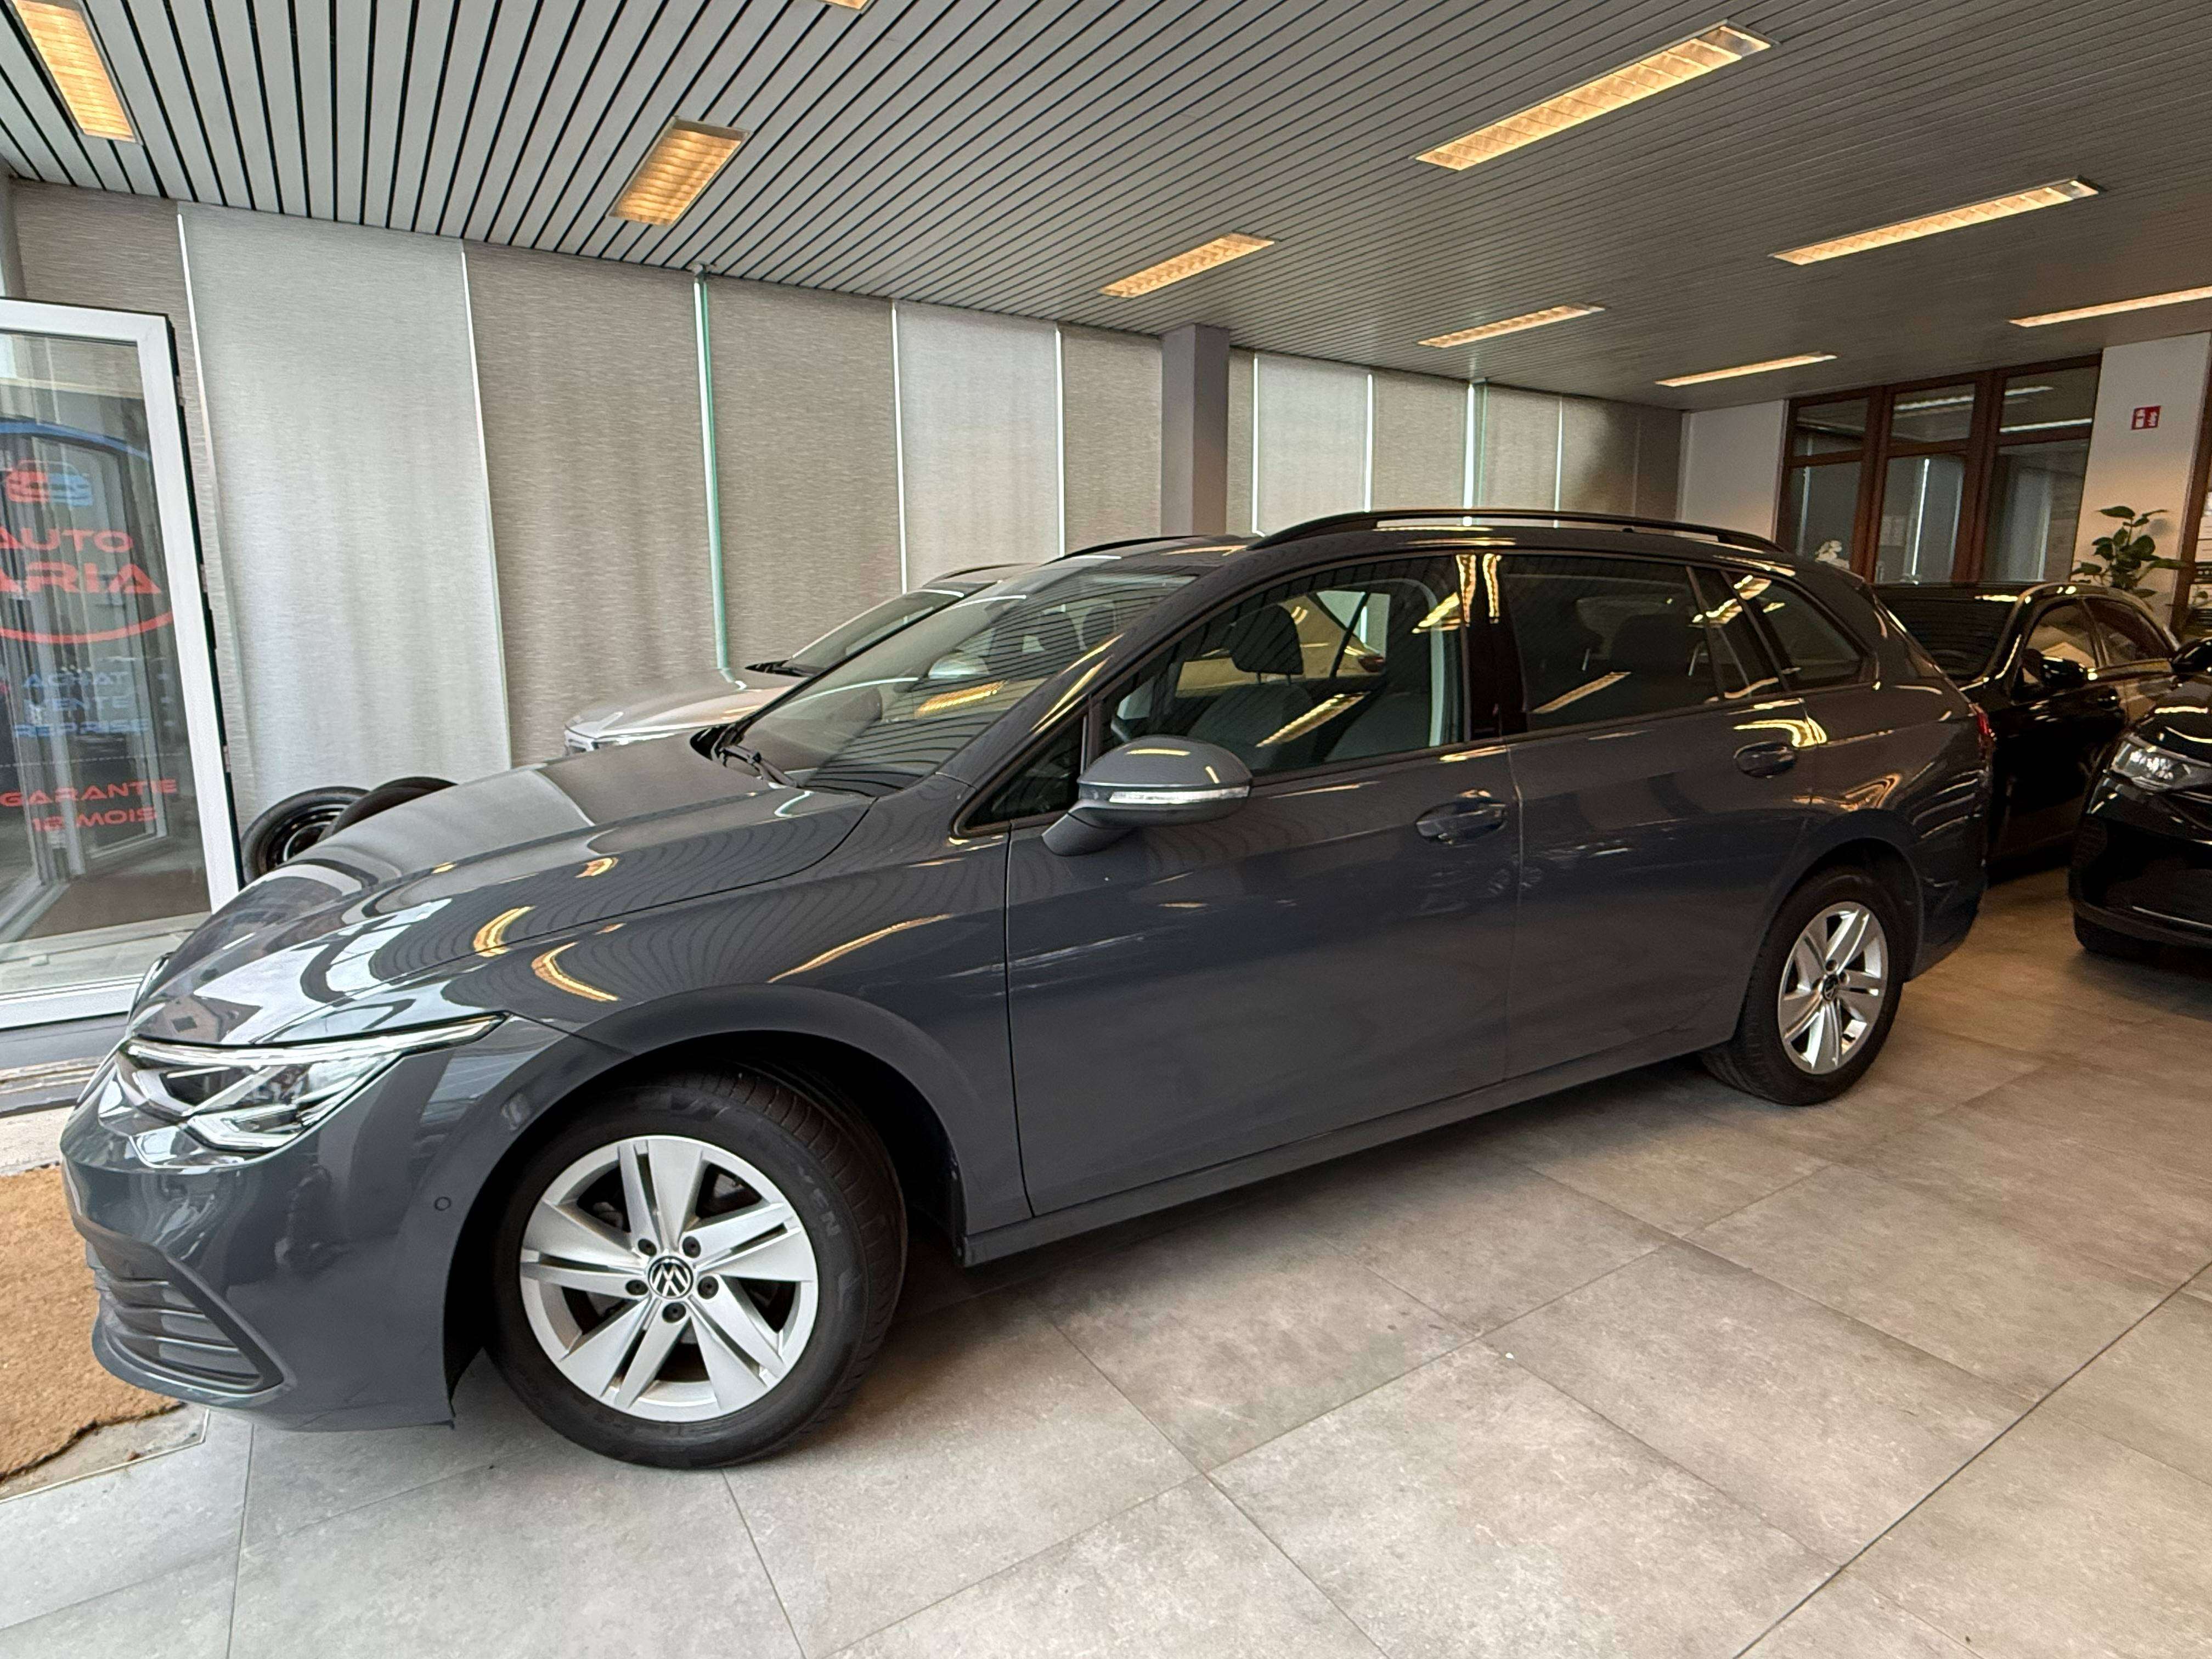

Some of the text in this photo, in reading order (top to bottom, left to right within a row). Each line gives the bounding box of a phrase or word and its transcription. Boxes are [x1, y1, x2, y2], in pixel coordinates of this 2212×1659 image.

[0, 526, 133, 552] AUTO
[15, 719, 149, 737] REPRISE
[0, 778, 177, 807] GARANTIE
[76, 807, 157, 828] MOIS
